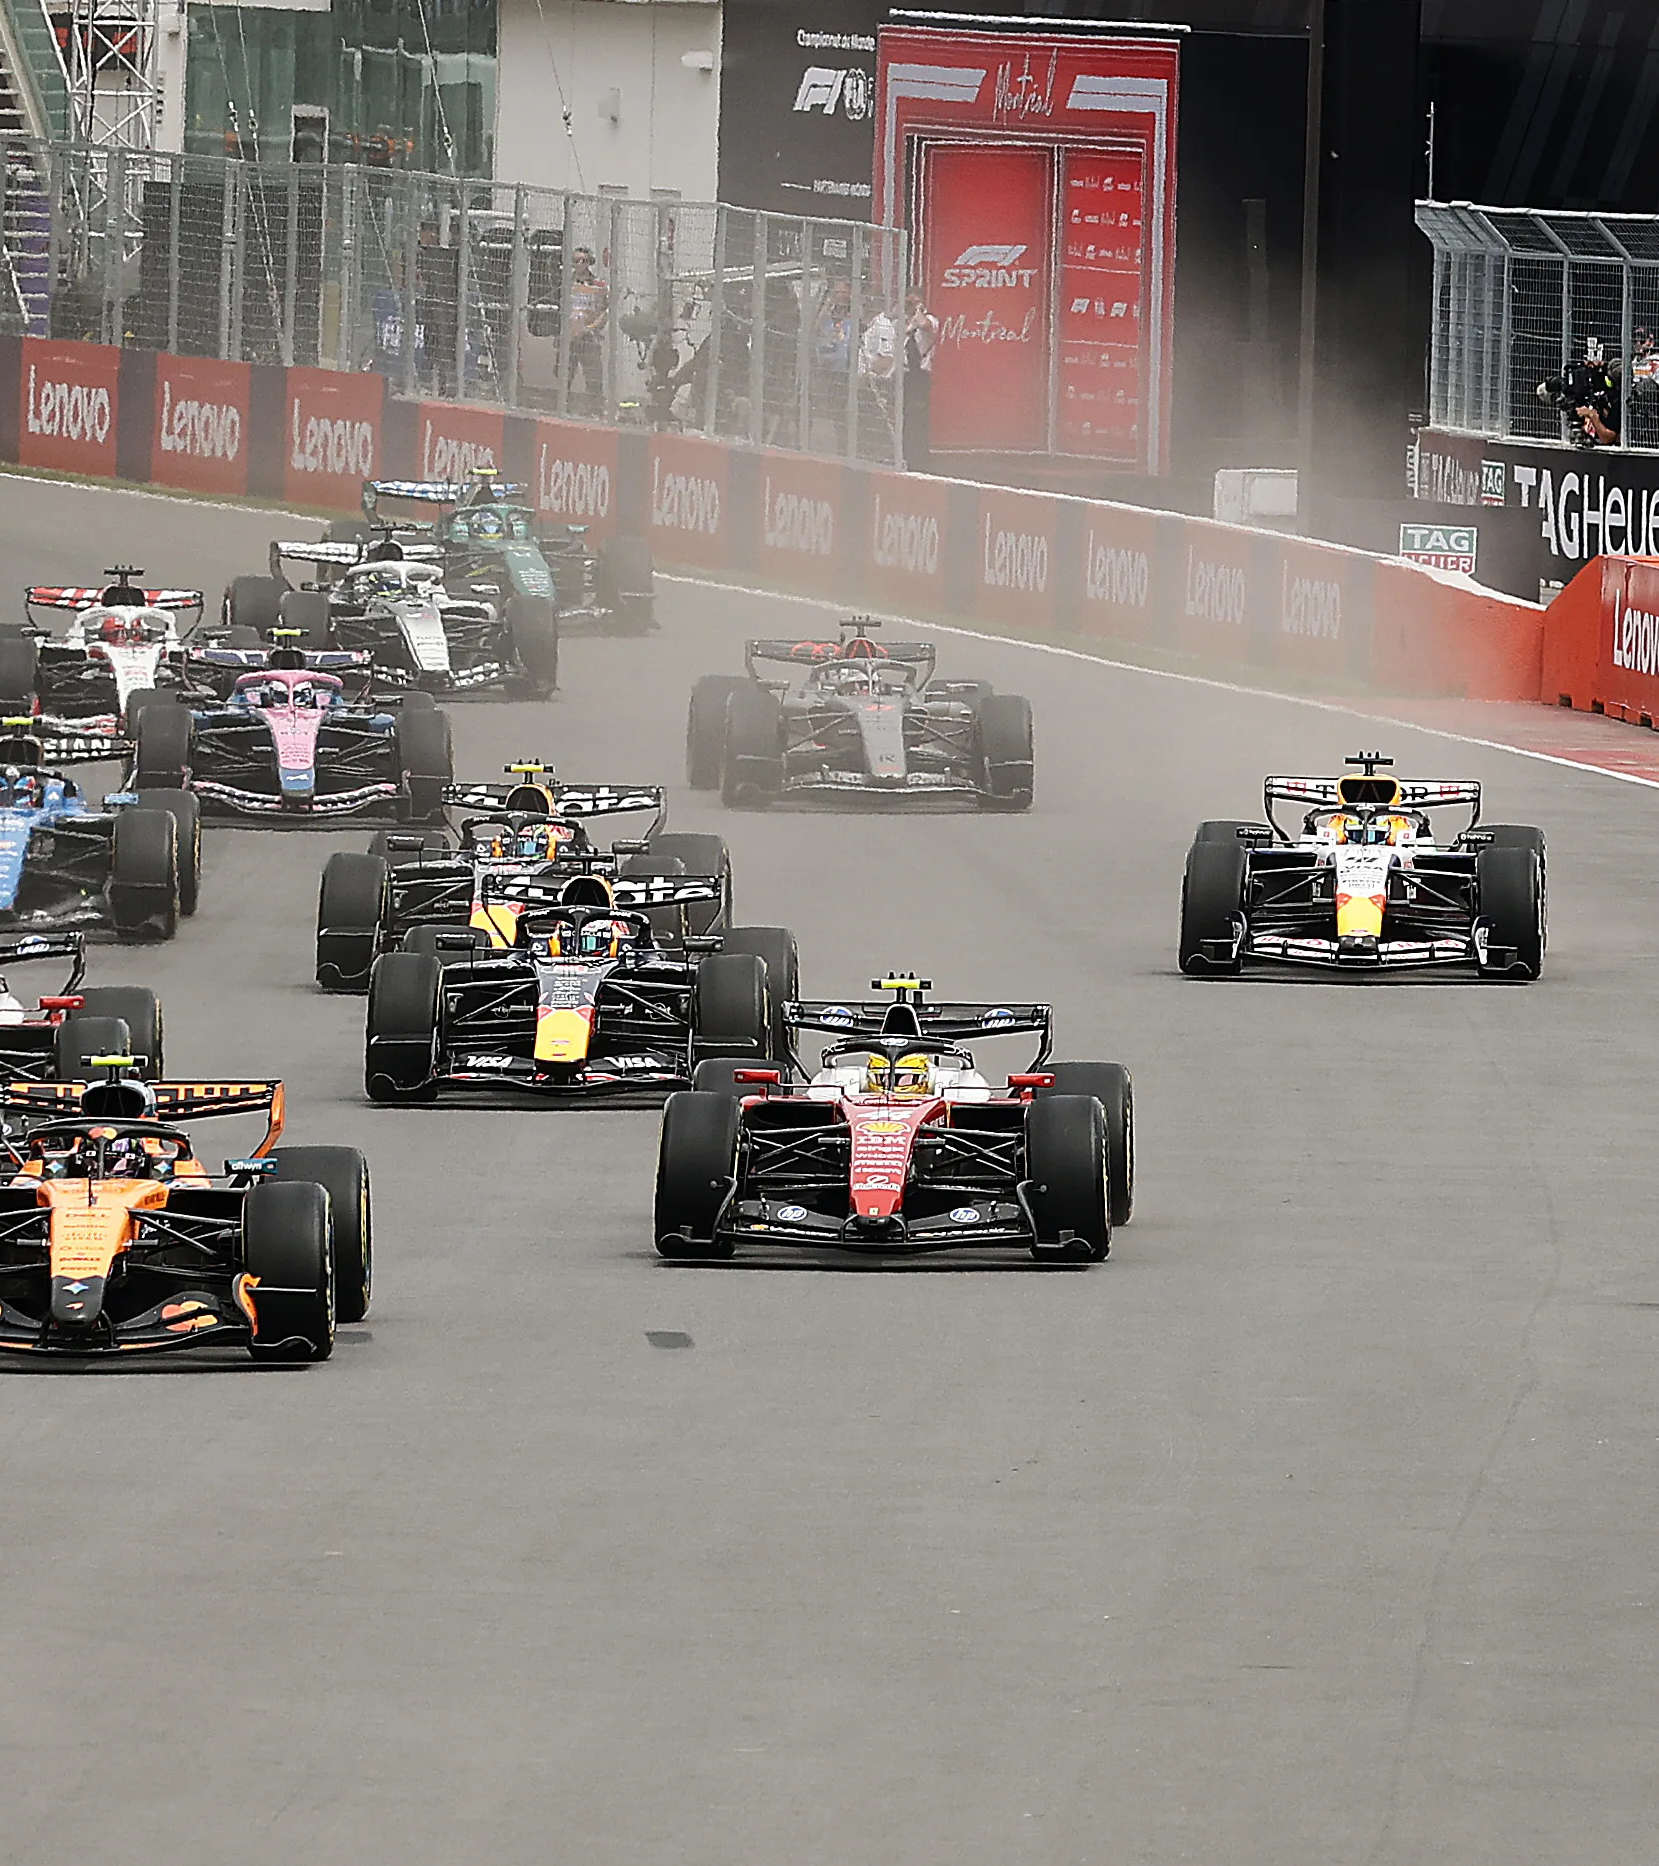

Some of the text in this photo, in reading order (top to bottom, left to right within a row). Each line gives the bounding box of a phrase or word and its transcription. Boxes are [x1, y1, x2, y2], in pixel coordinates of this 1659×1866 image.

[941, 268, 1038, 288] SPRINT
[27, 363, 111, 443] Lenovo
[161, 381, 240, 461] Lenovo
[291, 398, 374, 477] Lenovo
[540, 443, 609, 517] Lenovo
[653, 457, 720, 534] Lenovo
[765, 477, 834, 555] Lenovo
[874, 494, 938, 574] Lenovo
[984, 512, 1047, 593] Lenovo
[1086, 530, 1149, 608] Lenovo
[1407, 529, 1469, 551] TAG
[1187, 545, 1245, 625] Lenovo
[1282, 559, 1341, 640] Lenovo
[1613, 588, 1659, 675] Lenov
[467, 1055, 661, 1068] VISA VISA
